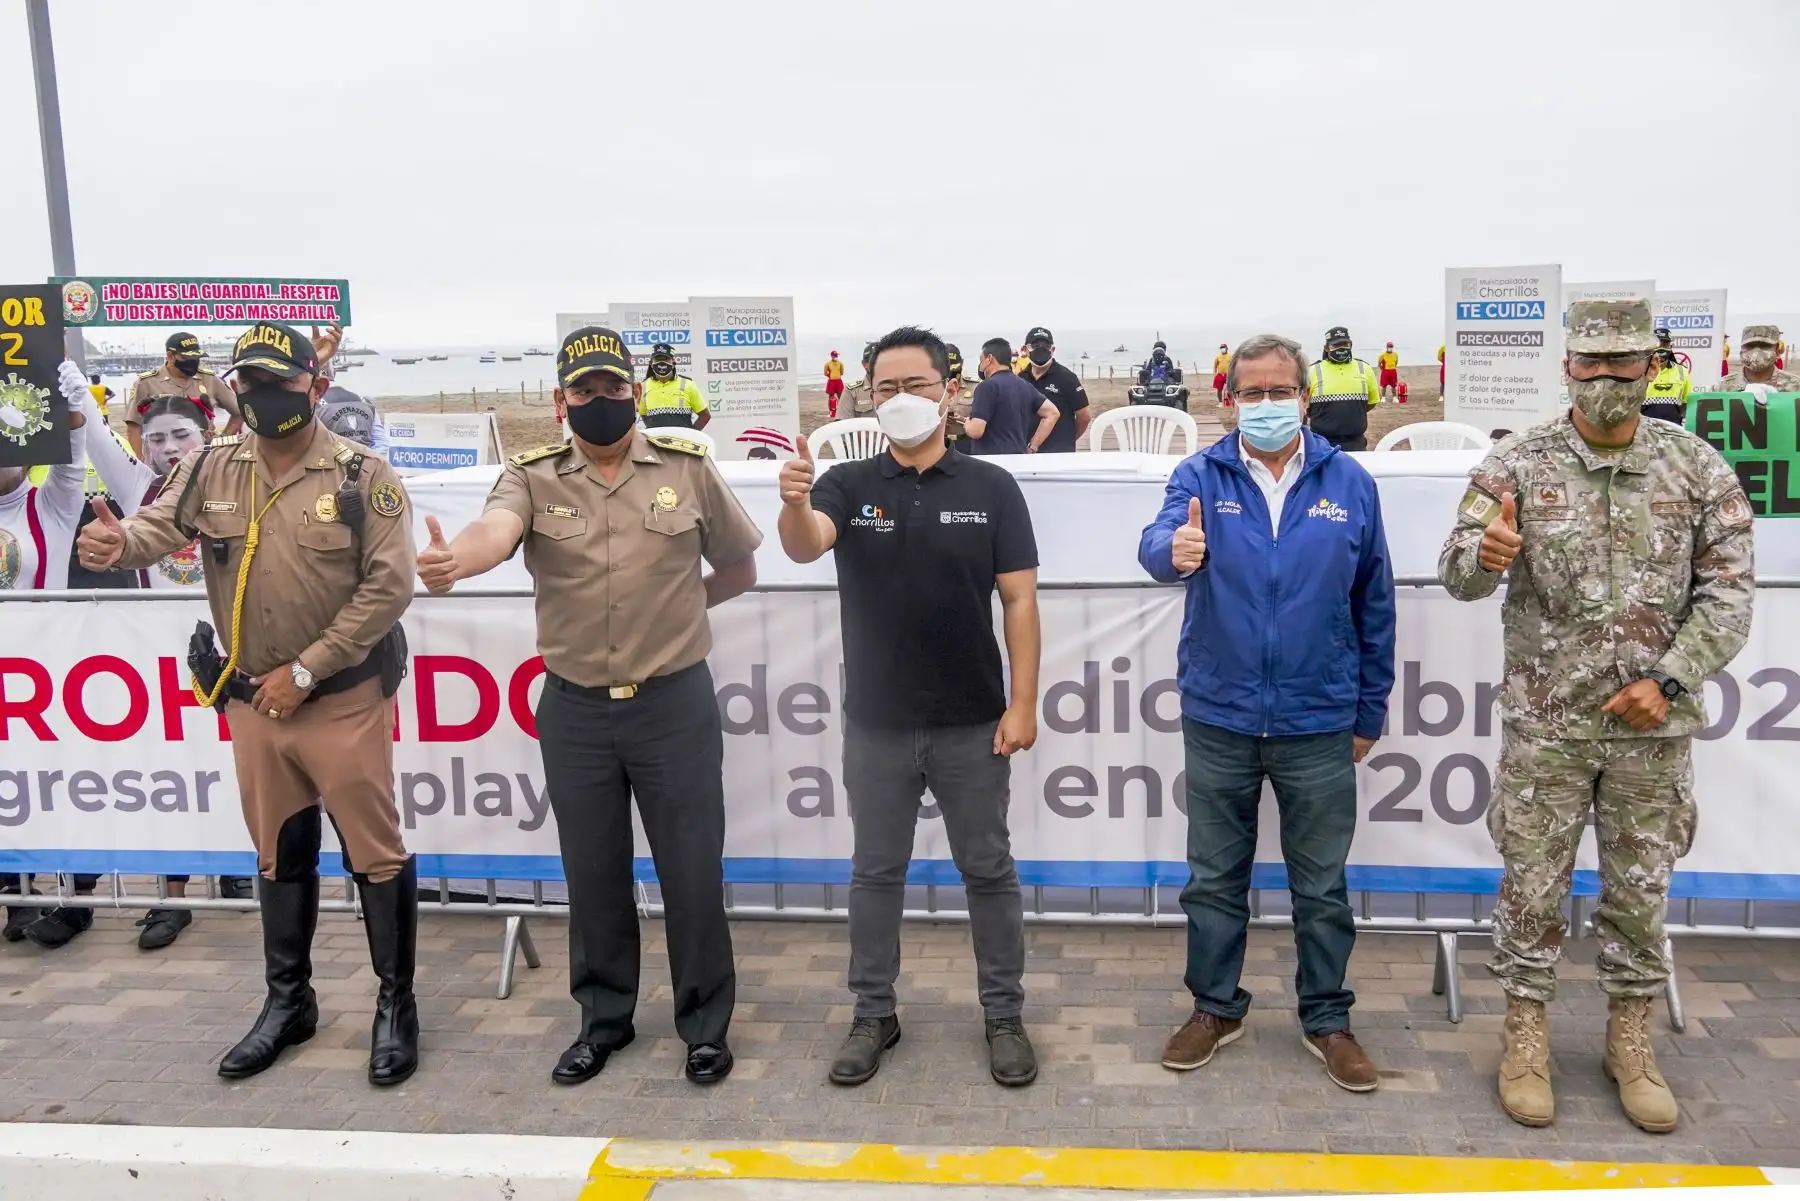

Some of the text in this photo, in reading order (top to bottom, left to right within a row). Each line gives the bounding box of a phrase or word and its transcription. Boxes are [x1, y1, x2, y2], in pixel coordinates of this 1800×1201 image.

[132, 283, 180, 300] BAJES
[181, 283, 200, 300] LA
[1479, 286, 1539, 298] Chorrillos
[1, 297, 46, 327] OR
[105, 303, 340, 322] TU DISTANCIA, USA MASCARILLA.
[1460, 302, 1543, 318] TE CUIDA
[1663, 304, 1710, 314] Chorrillos
[726, 315, 780, 326] Chorrillos
[1667, 316, 1711, 328] CUIDA
[235, 325, 293, 359] POLICIA
[625, 331, 645, 344] TE
[709, 331, 786, 345] TE CUIDA
[1460, 332, 1541, 345] PRECAUCIÓN
[565, 335, 624, 365] POLICIA
[1518, 350, 1540, 359] playa
[711, 360, 785, 373] RECUERDA
[1469, 374, 1534, 384] dolor de cabeza
[1469, 384, 1539, 396] dolor de garganta
[1469, 396, 1482, 404] tos
[1491, 396, 1515, 406] fiebre
[277, 414, 303, 433] POLICIA
[1695, 398, 1768, 451] EN
[393, 451, 474, 466] AFORO PERMITIDO
[850, 516, 895, 527] chorrillos
[716, 663, 847, 735] de
